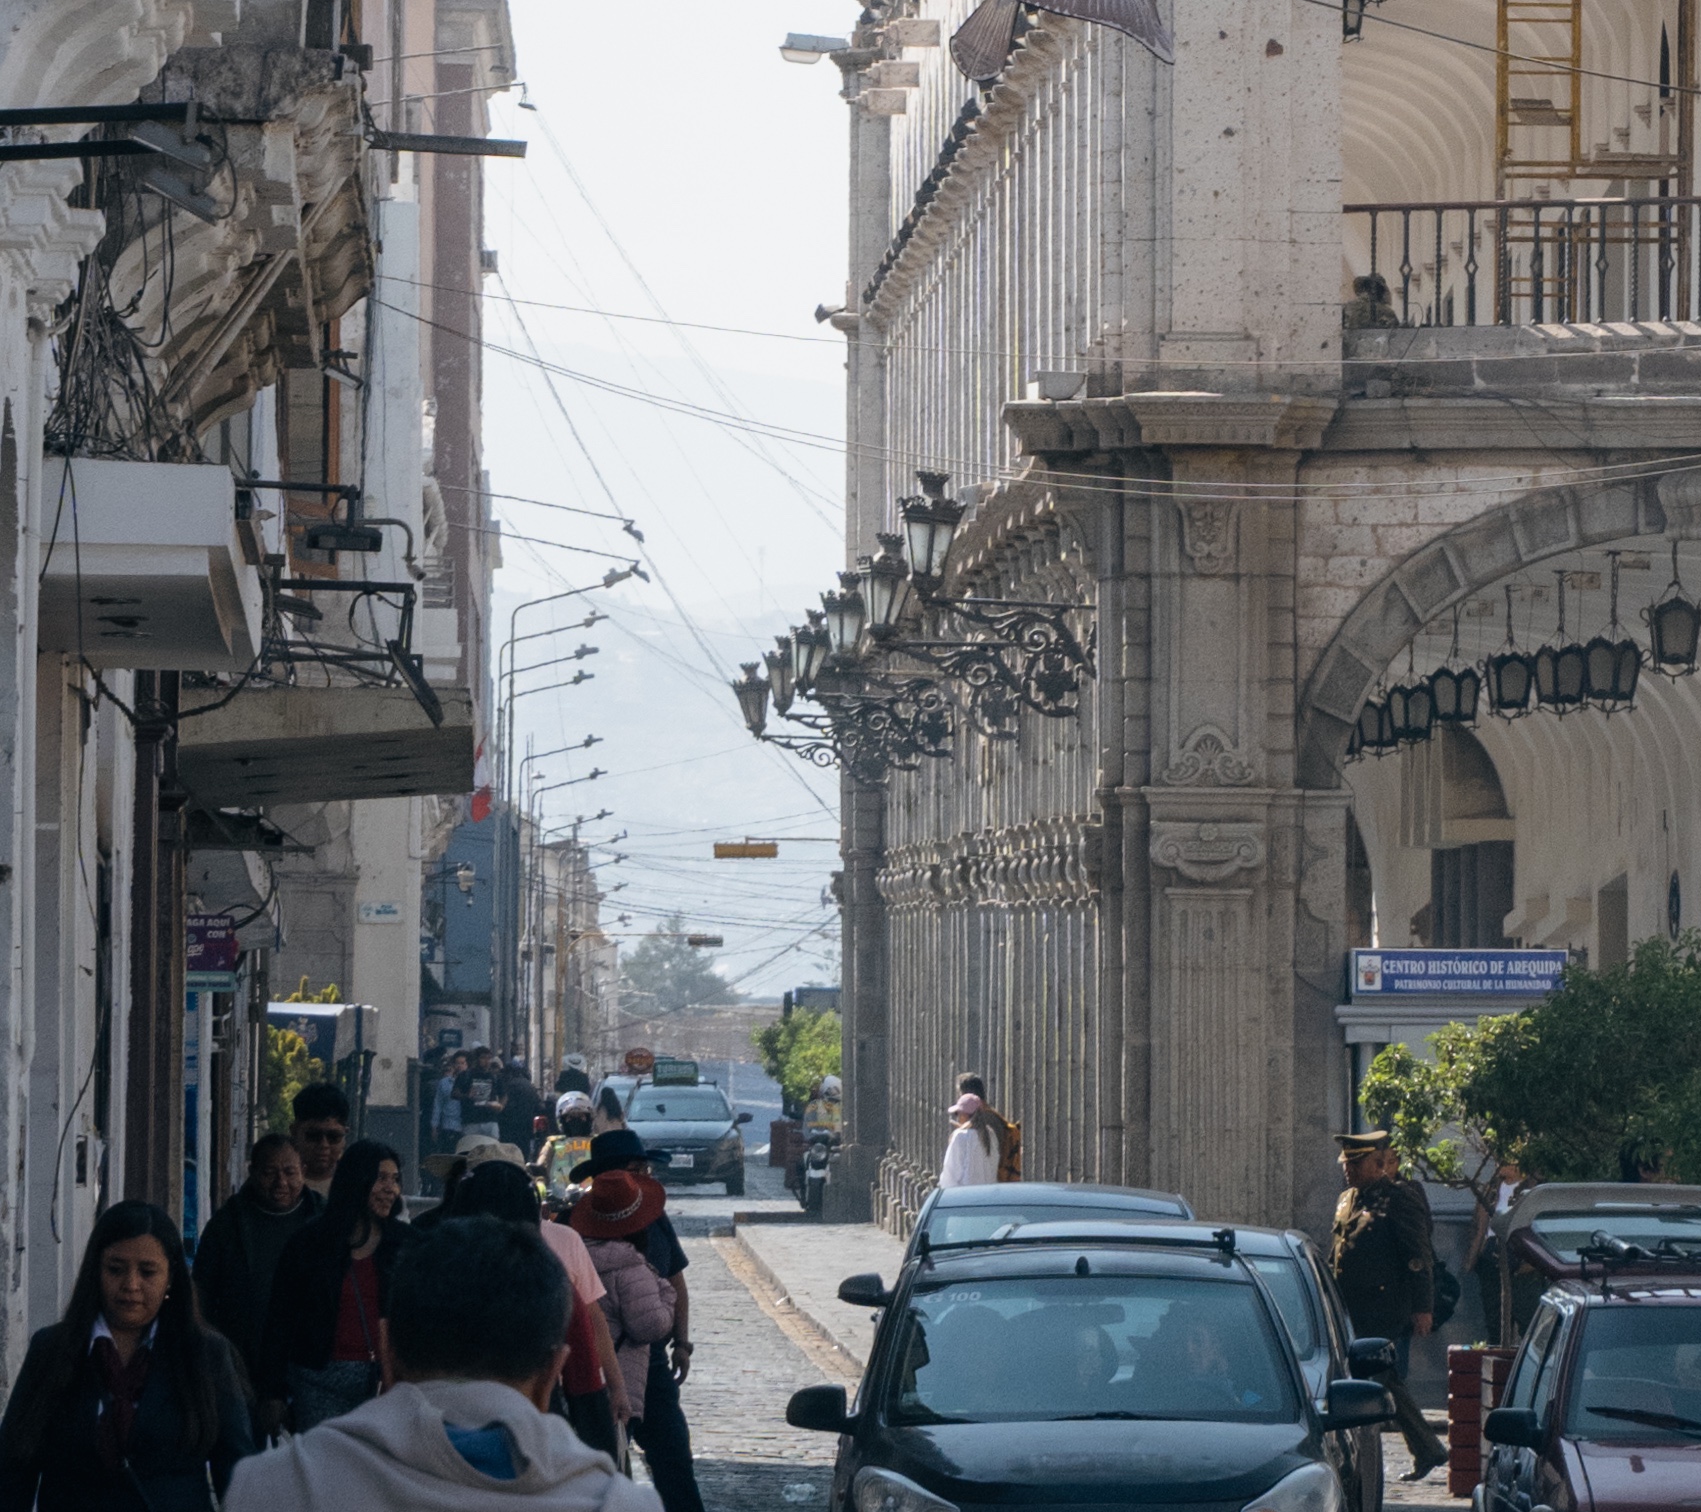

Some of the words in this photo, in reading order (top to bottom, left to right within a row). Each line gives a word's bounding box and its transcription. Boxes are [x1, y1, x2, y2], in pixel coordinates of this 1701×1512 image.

[1382, 959, 1425, 975] CENTRO
[1428, 956, 1488, 975] HISTÓRICO
[1490, 959, 1505, 975] DE
[1506, 959, 1562, 978] AREQUIPA
[1394, 979, 1442, 990] PATRIMONIO
[1443, 979, 1481, 990] CULTURAL
[1483, 979, 1493, 990] DE
[1494, 979, 1504, 990] LA
[1505, 979, 1552, 990] HUMANIDAD
